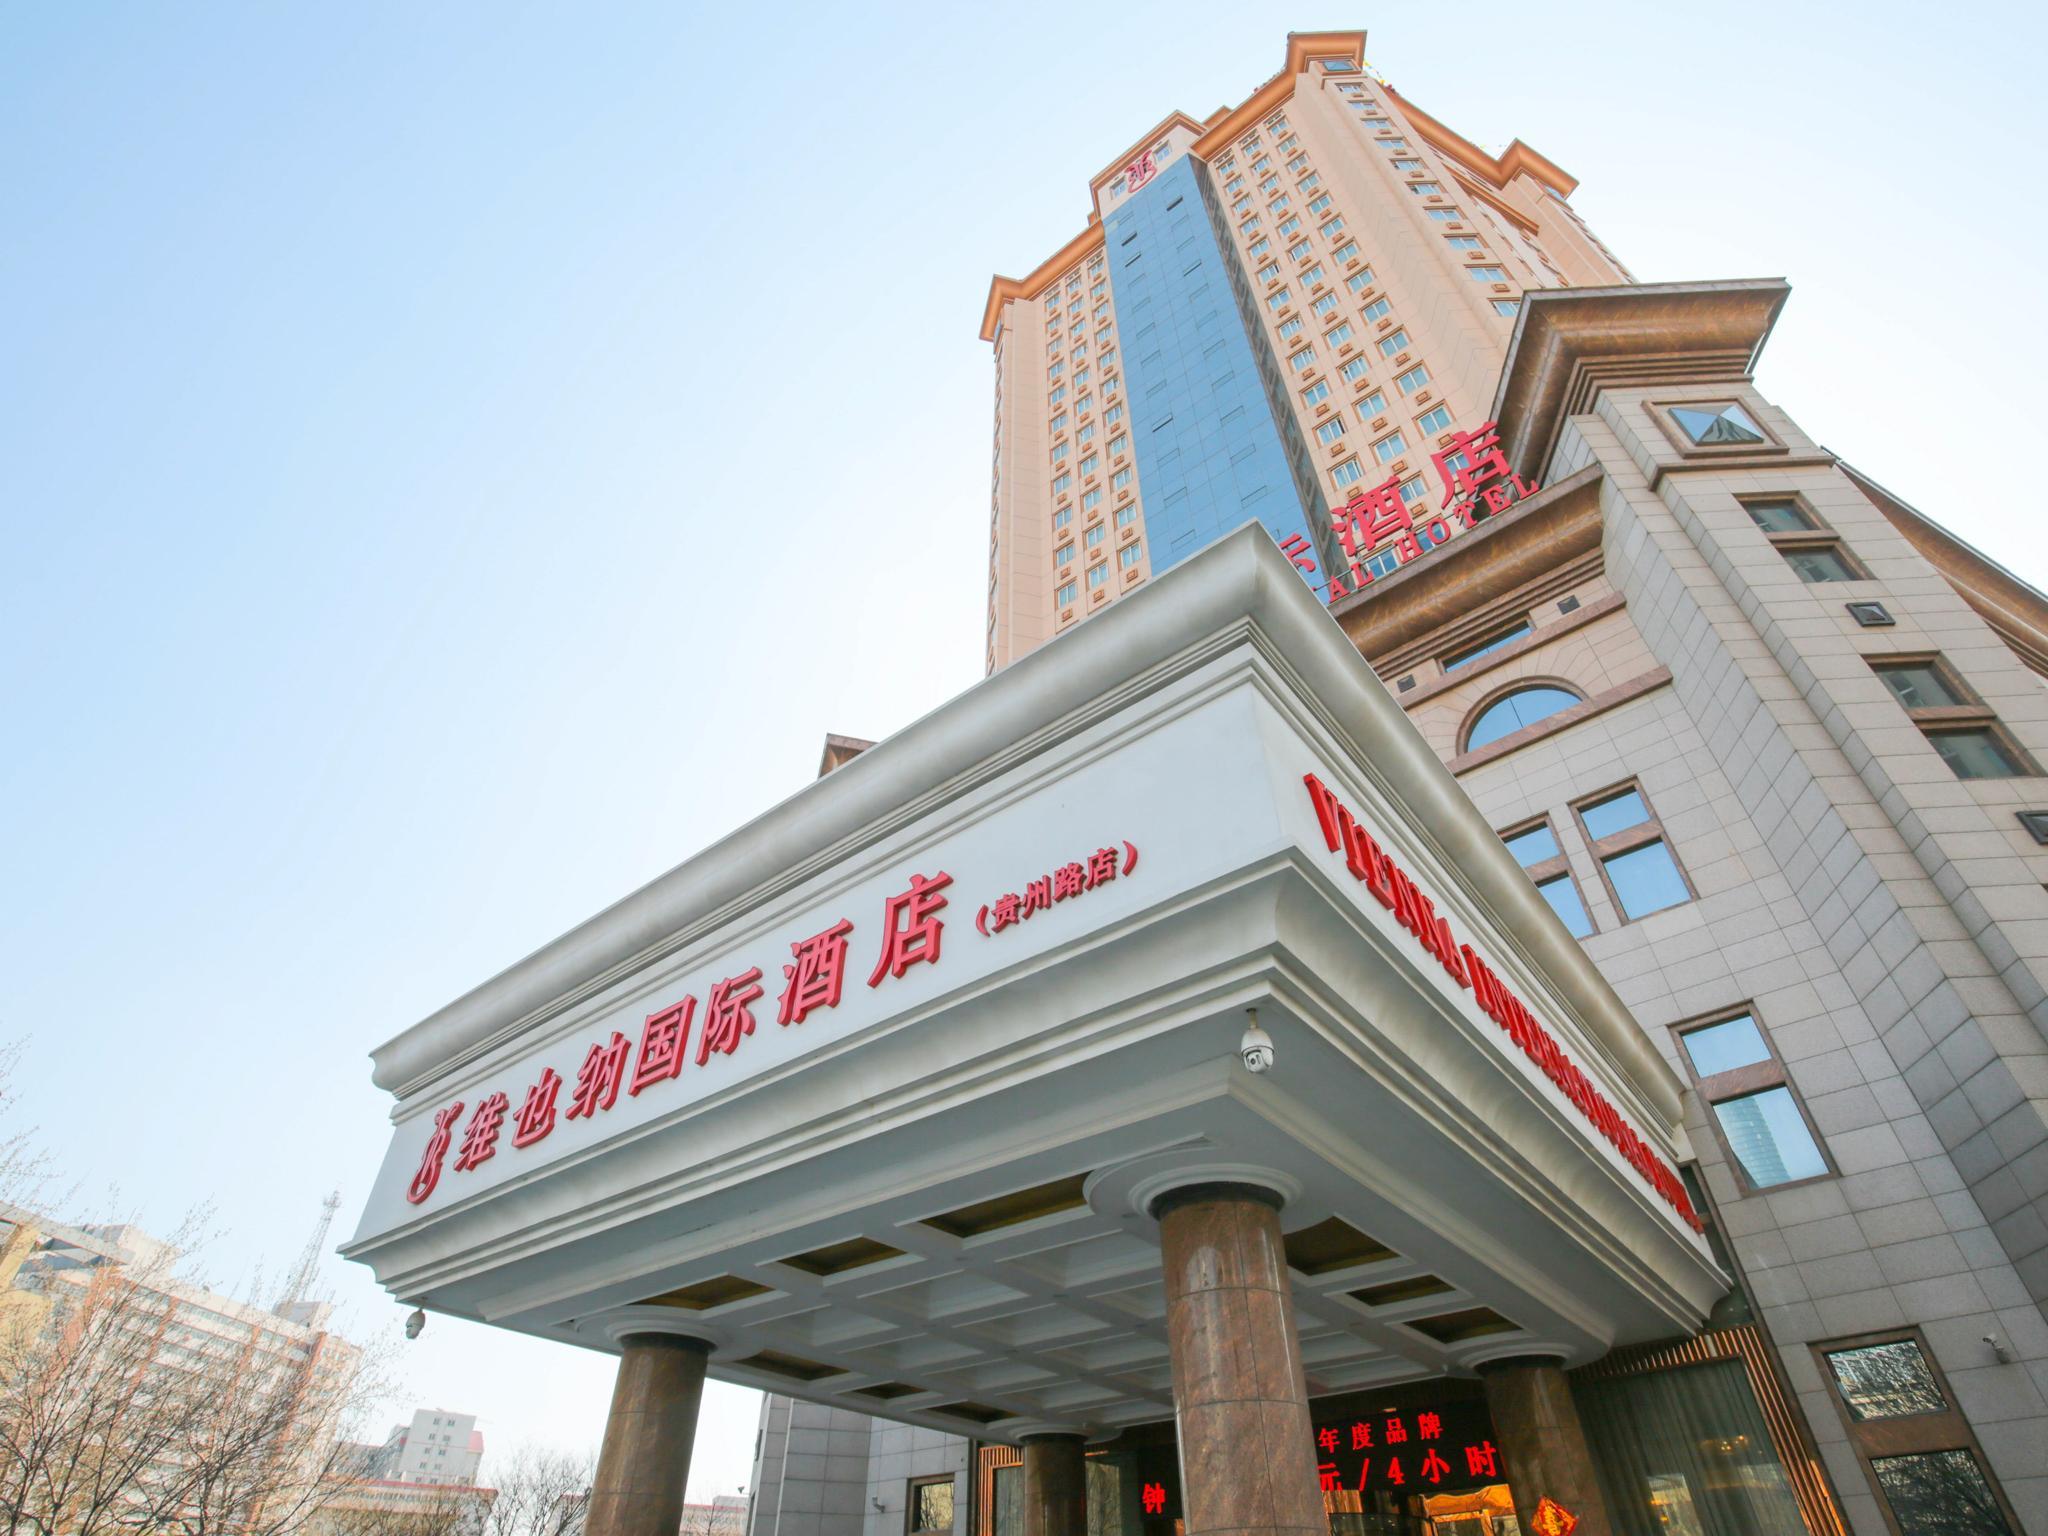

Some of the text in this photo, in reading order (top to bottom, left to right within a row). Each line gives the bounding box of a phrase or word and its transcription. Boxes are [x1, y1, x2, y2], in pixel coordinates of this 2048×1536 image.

[1311, 472, 1540, 603] AL HOTEL
[1303, 772, 1471, 989] VIENNA
[453, 840, 1139, 1171] 维也纳国际酒店 (贵州路店)
[1318, 1411, 1444, 1455] 年度品牌
